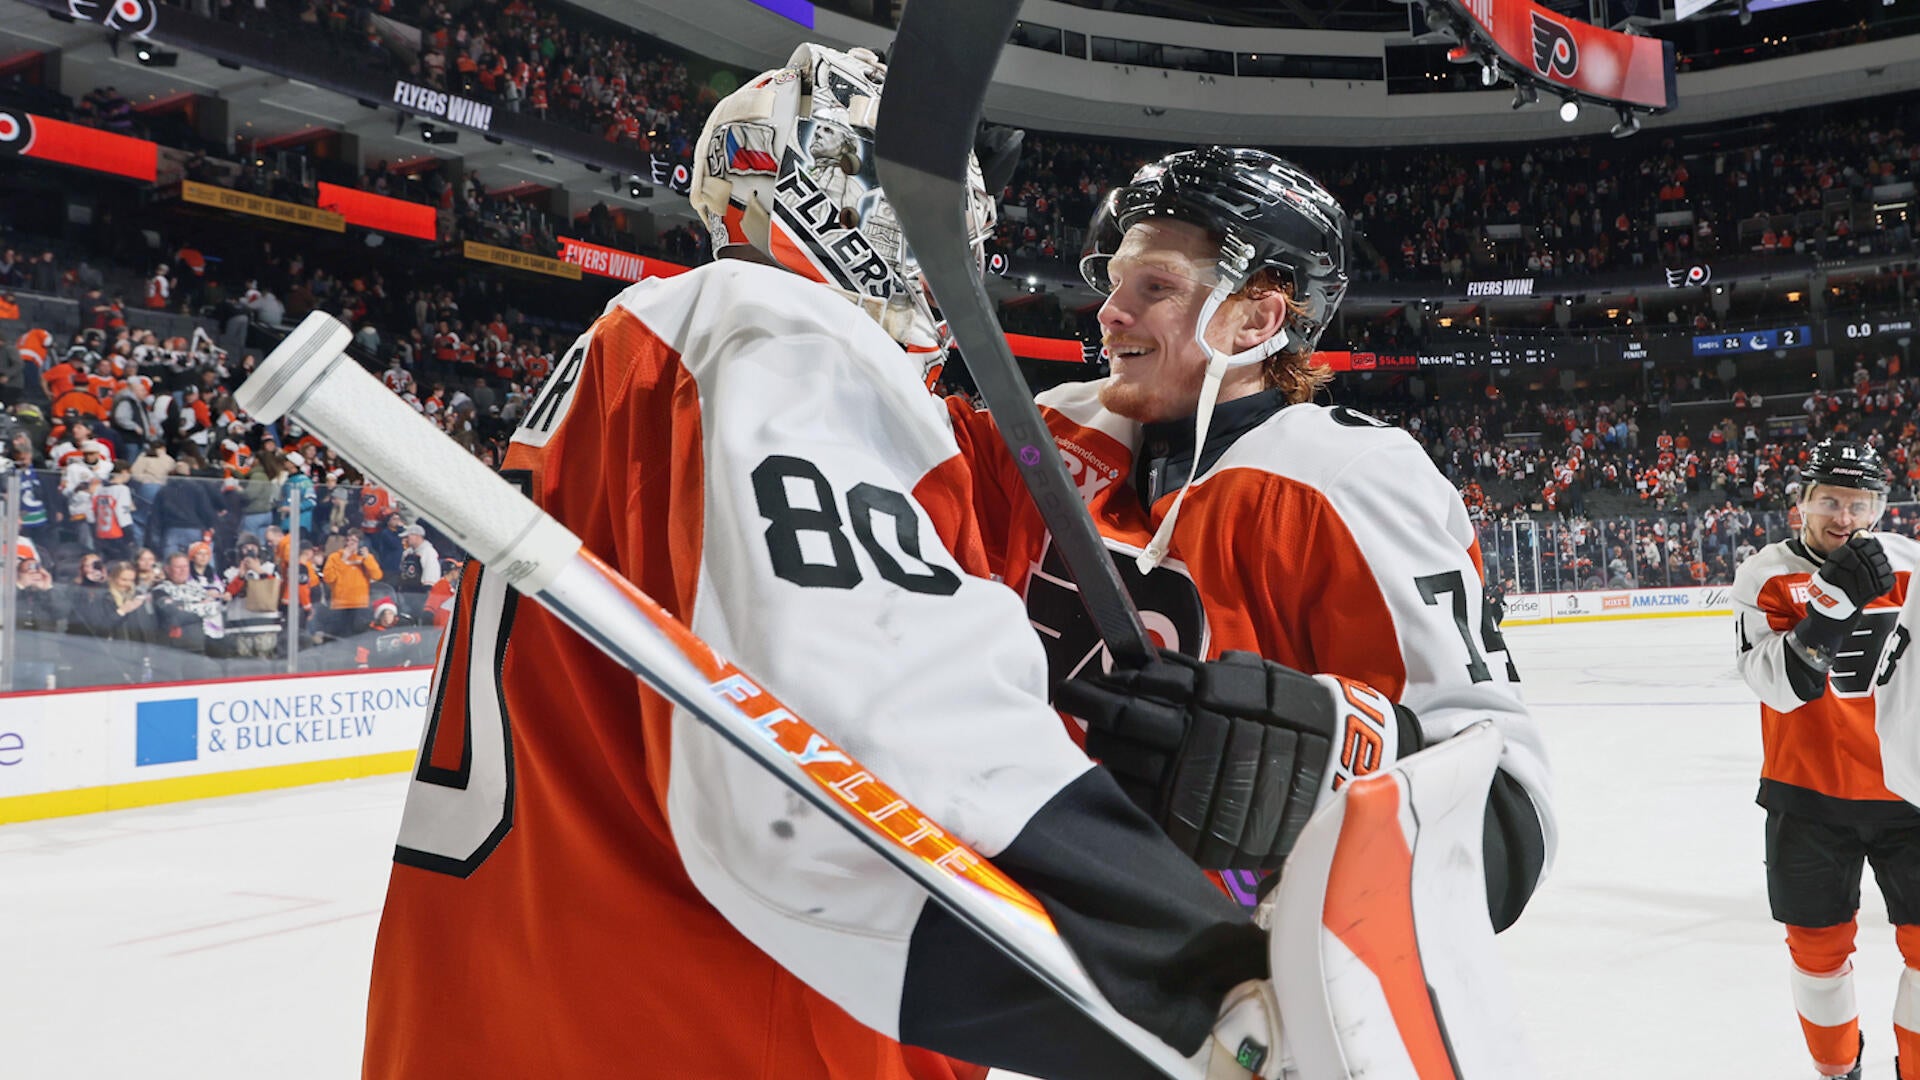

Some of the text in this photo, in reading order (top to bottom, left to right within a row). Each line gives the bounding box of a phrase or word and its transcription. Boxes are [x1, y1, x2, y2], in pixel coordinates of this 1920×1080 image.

[393, 80, 492, 131] FLYERS WIN!
[775, 173, 895, 300] FLYERS
[565, 244, 645, 280] FLYERS WIN!
[1467, 278, 1534, 296] FLYERS WIN!
[1726, 339, 1739, 348] 24
[1784, 331, 1794, 345] 2
[1847, 323, 1871, 338] 0.0
[1440, 356, 1453, 364] PM
[1841, 447, 1857, 460] 11
[750, 455, 962, 596] 80
[1632, 594, 1690, 607] AMAZING
[1415, 570, 1521, 684] 74
[208, 686, 429, 726] CONNER STRONG
[208, 715, 376, 753] & BUCKELEW
